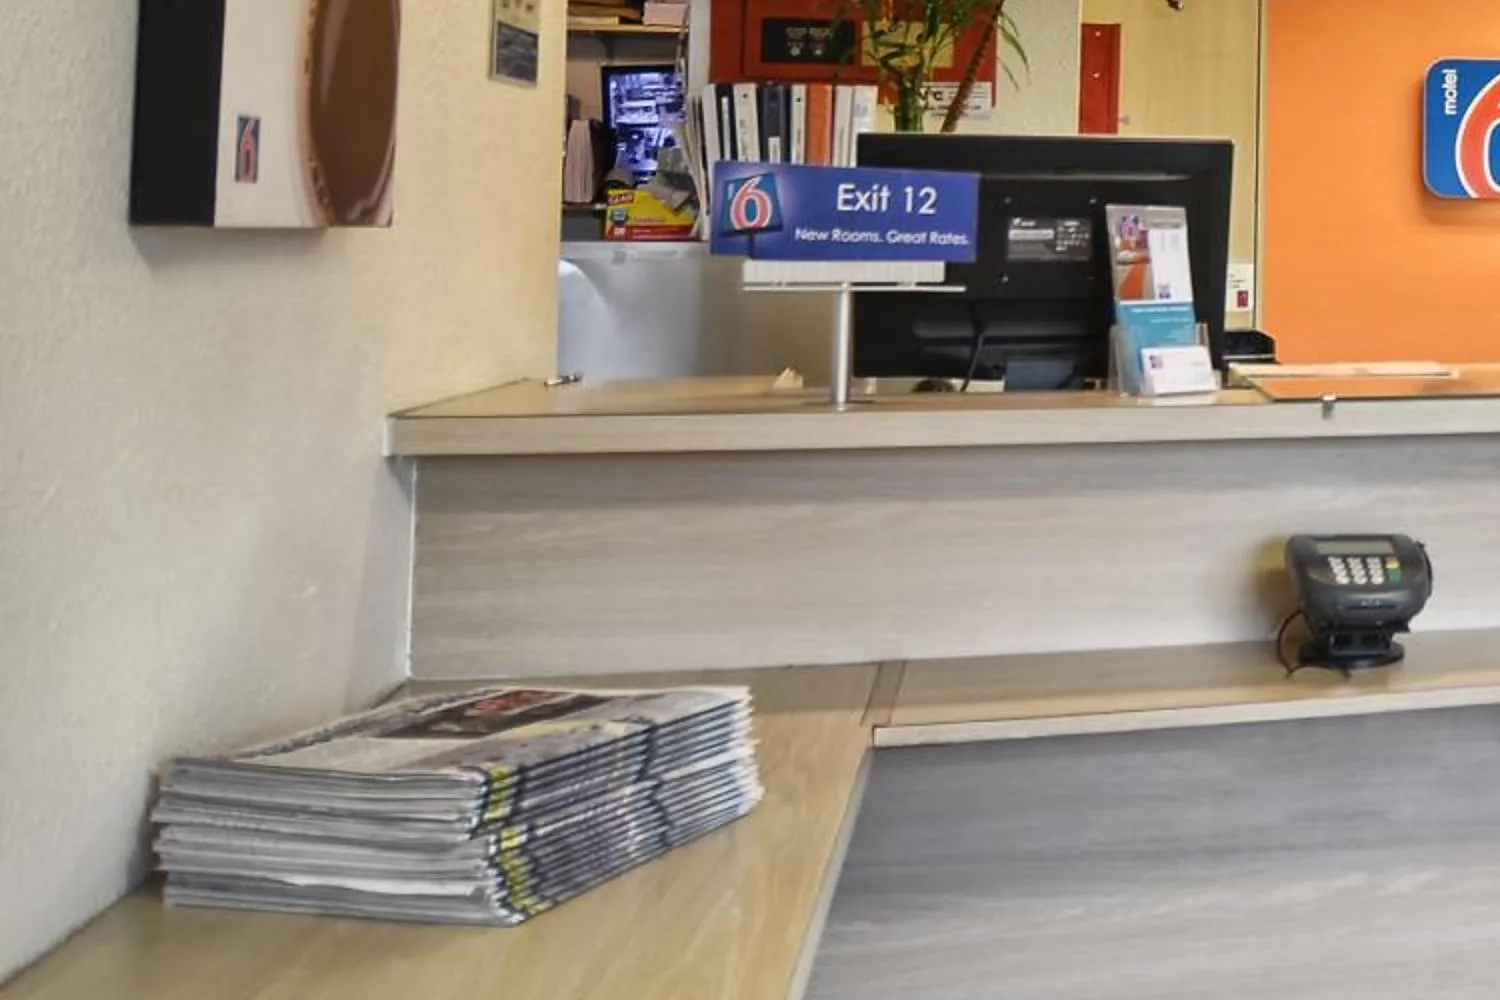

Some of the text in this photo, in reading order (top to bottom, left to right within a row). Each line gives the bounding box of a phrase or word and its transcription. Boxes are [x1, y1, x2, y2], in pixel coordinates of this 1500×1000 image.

[1442, 69, 1458, 115] motel
[730, 175, 772, 229] 6
[836, 183, 938, 215] Exit 12
[795, 228, 972, 246] New Rooms. Great Rates.
